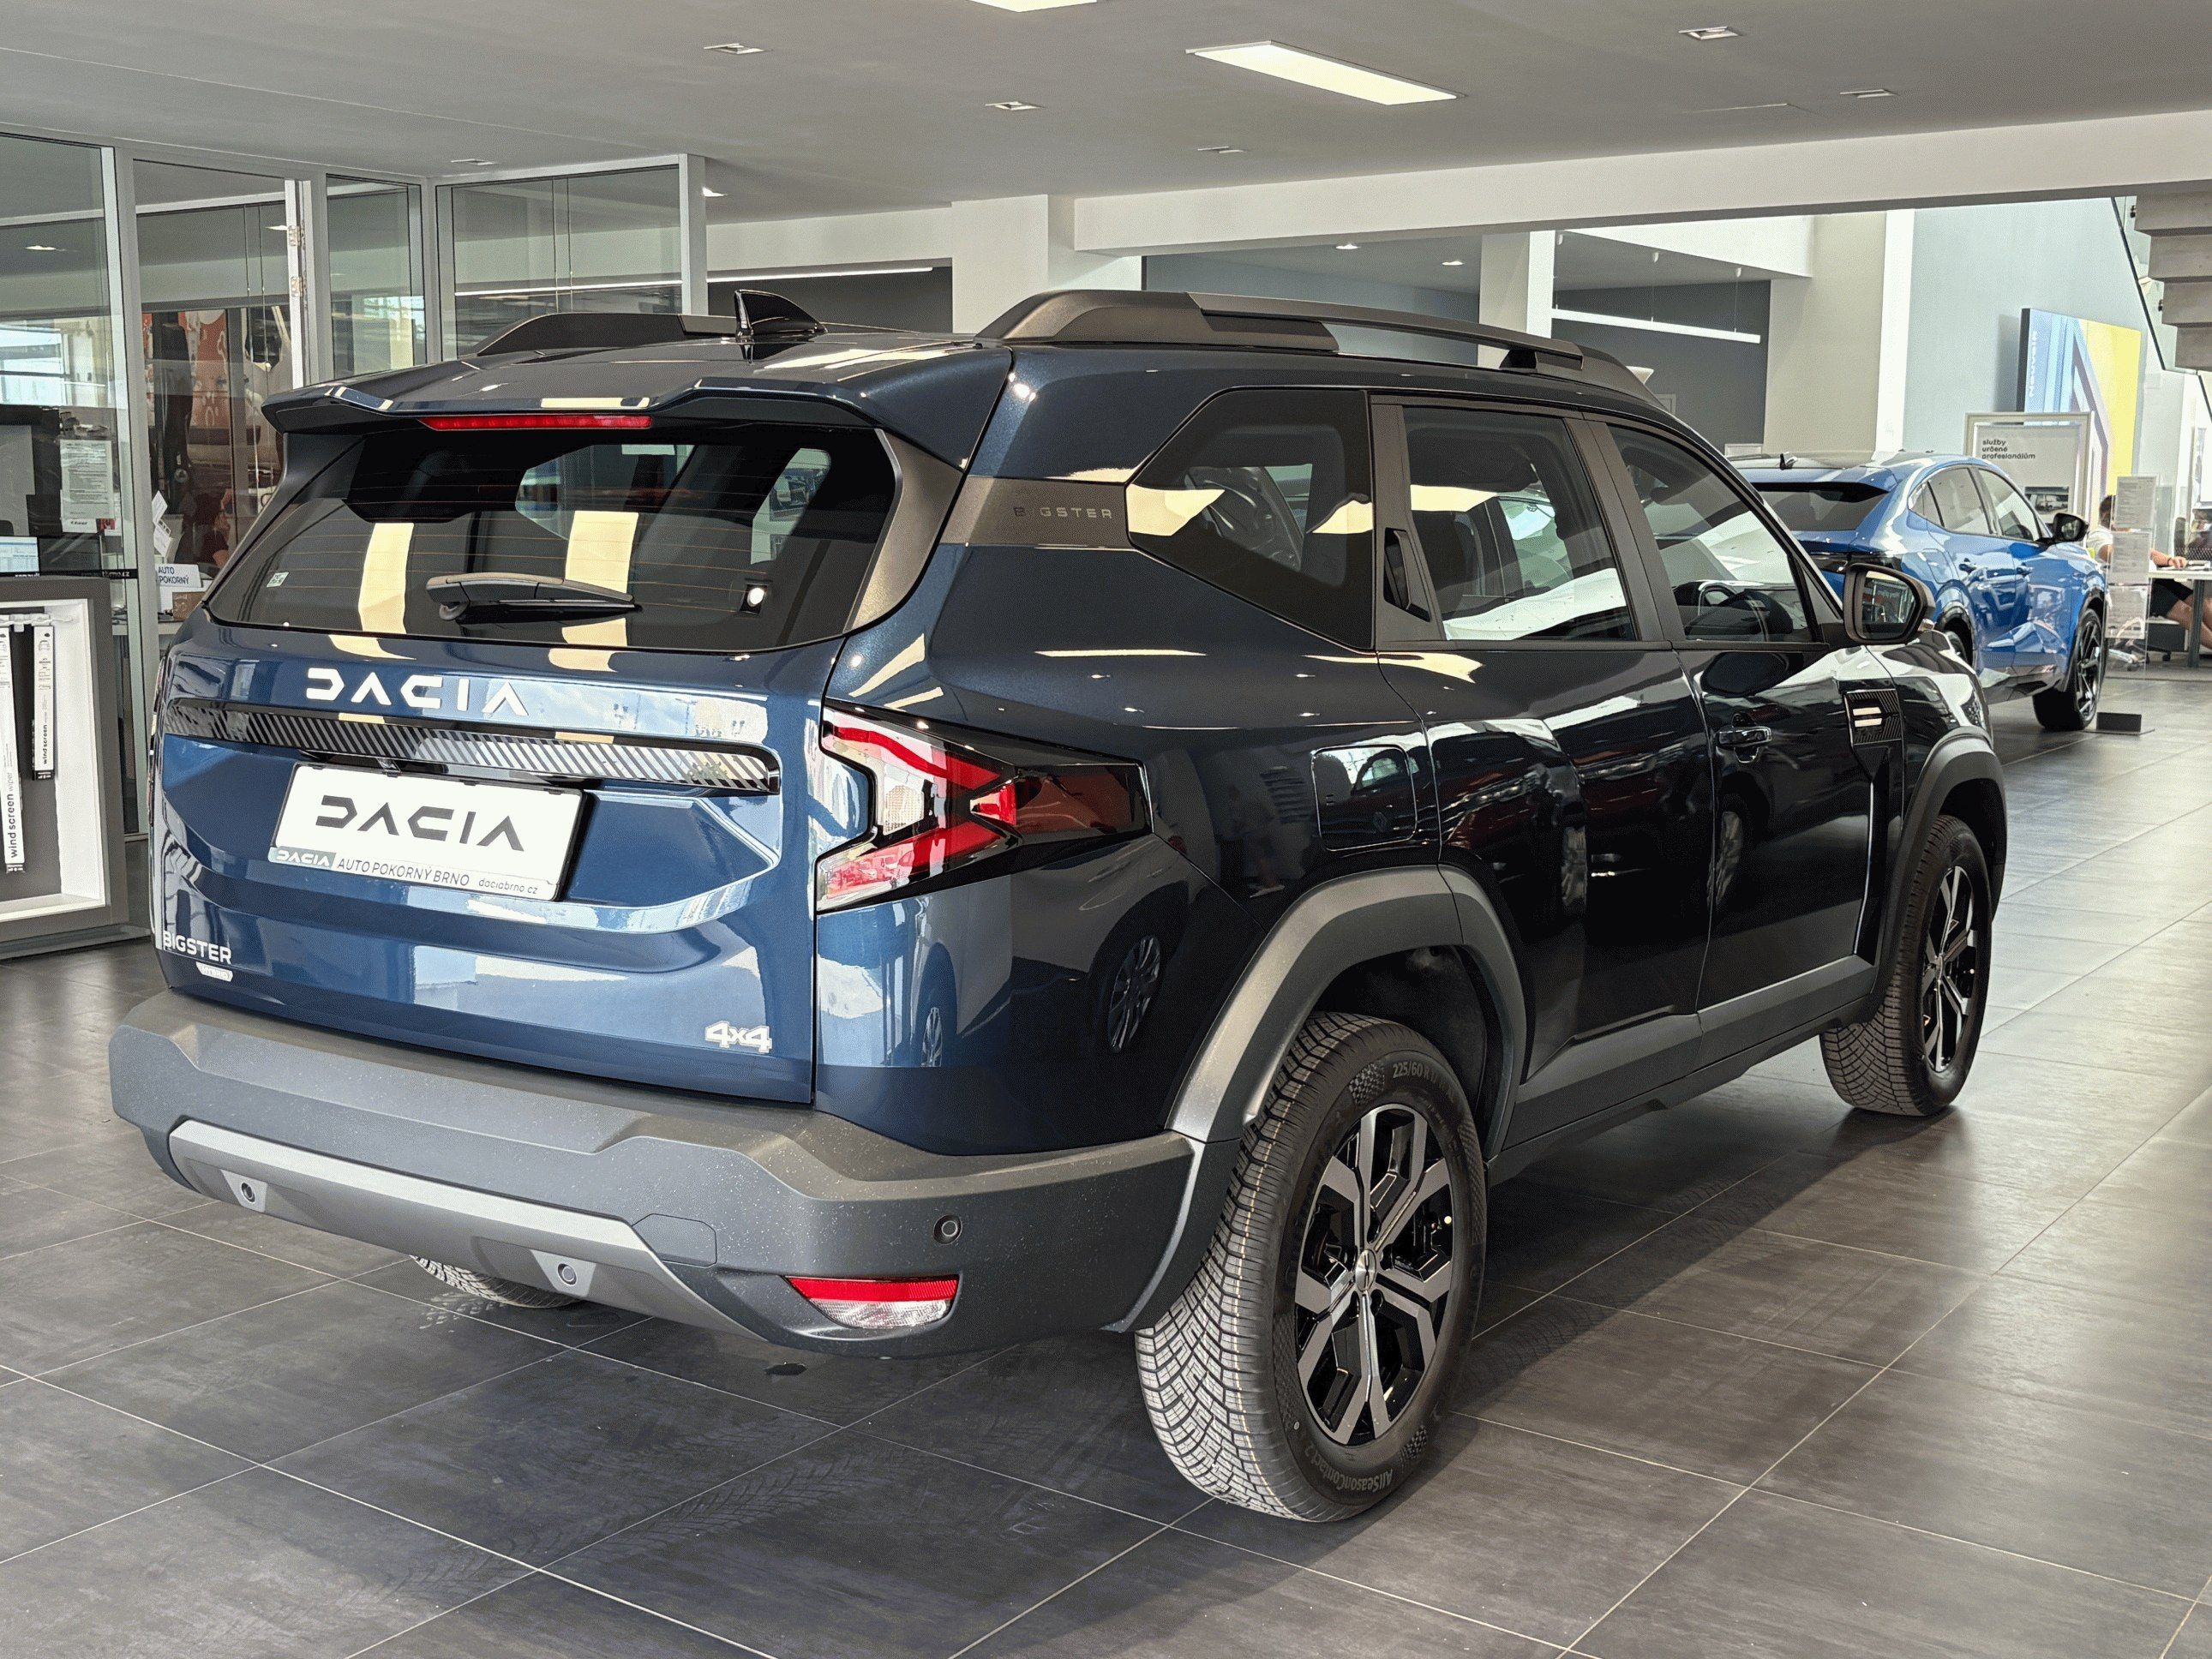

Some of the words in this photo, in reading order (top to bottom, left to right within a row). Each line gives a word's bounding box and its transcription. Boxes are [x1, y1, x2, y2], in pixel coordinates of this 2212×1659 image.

[1013, 506, 1112, 519] BGSTER
[158, 566, 175, 575] AUTO
[306, 667, 529, 716] DACIA
[7, 794, 16, 830] screen
[315, 794, 525, 852] DACIA
[8, 831, 18, 858] wind
[276, 849, 330, 867] DACIA
[337, 858, 370, 872] AUTO
[372, 862, 432, 882] POKORNÝ
[433, 871, 470, 887] BRNO
[478, 877, 538, 895] daciabrnocz
[163, 931, 232, 965] BIGSTER
[705, 1020, 772, 1054] 4x4
[1393, 1061, 1423, 1079] 225/60
[1310, 1453, 1394, 1492] AllSeasonContact
